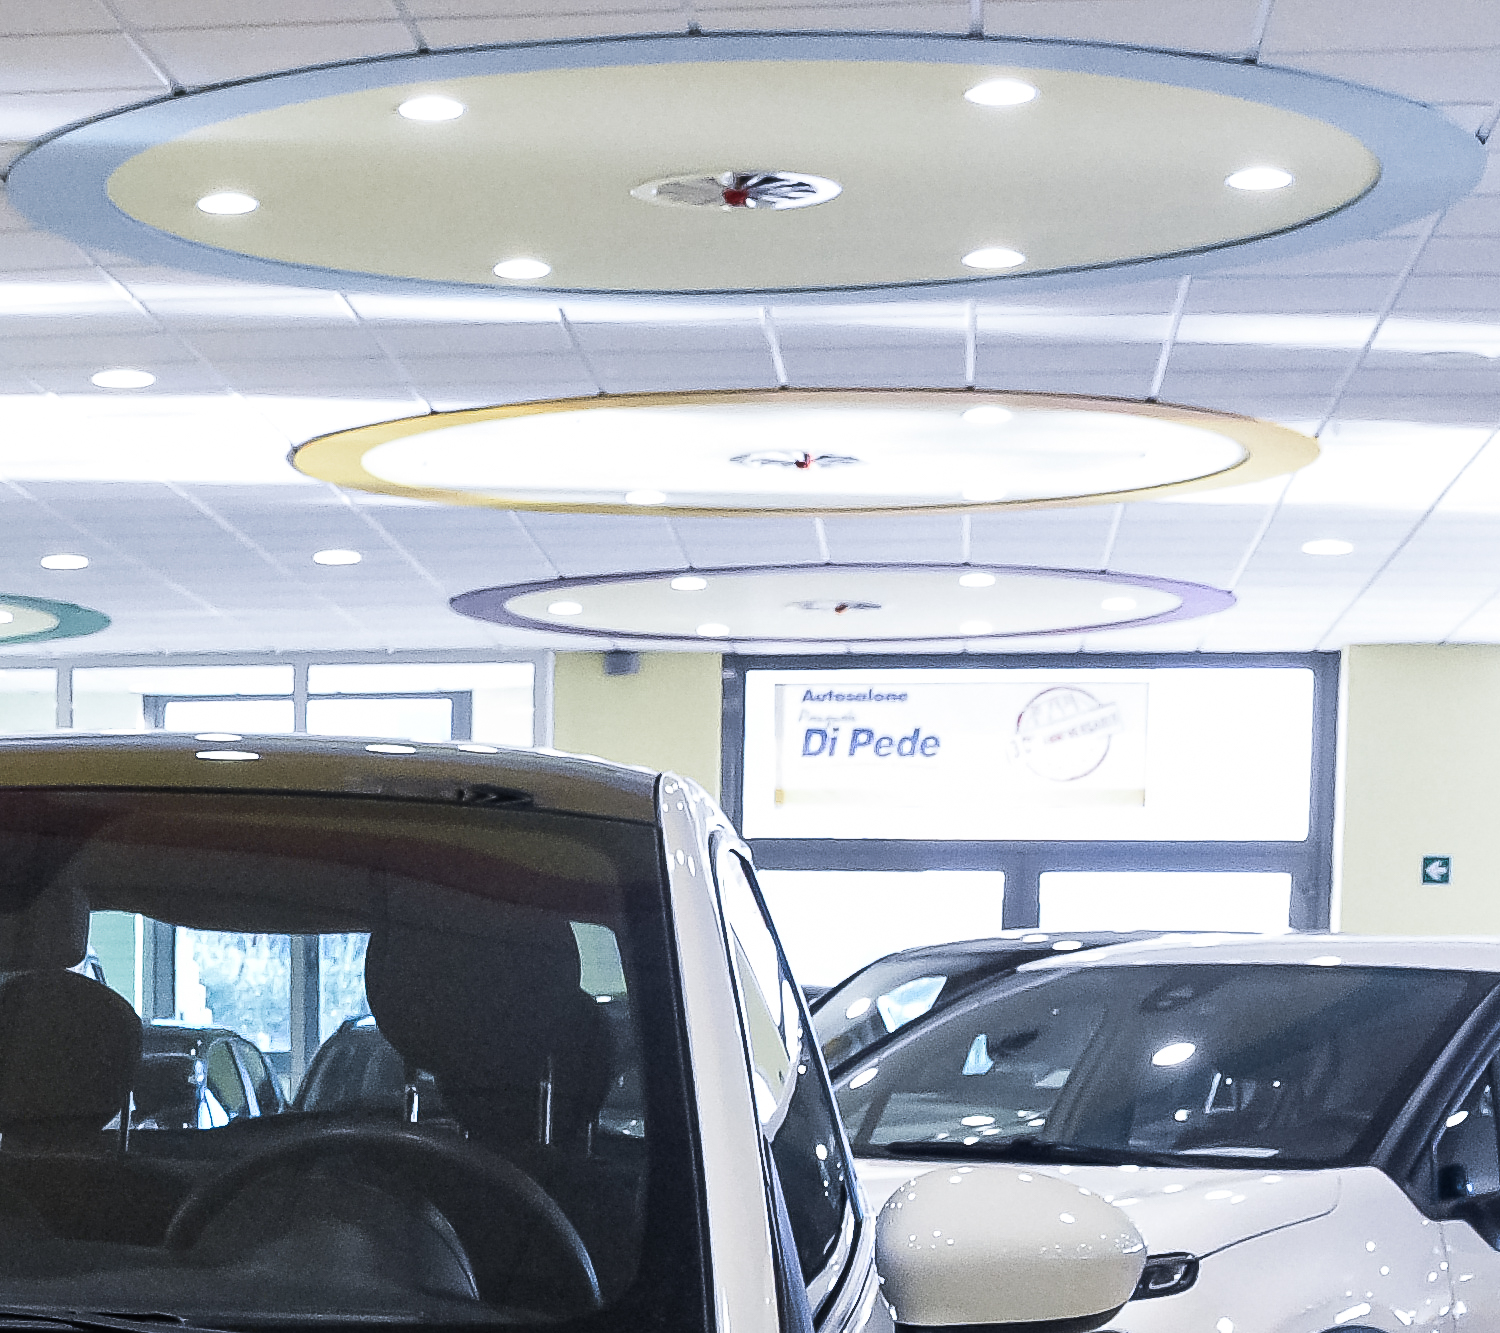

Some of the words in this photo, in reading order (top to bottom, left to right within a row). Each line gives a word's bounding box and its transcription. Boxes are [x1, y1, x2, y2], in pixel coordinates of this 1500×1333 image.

[801, 688, 908, 703] Autosalone
[802, 727, 840, 757] Di
[848, 727, 941, 757] Pede
